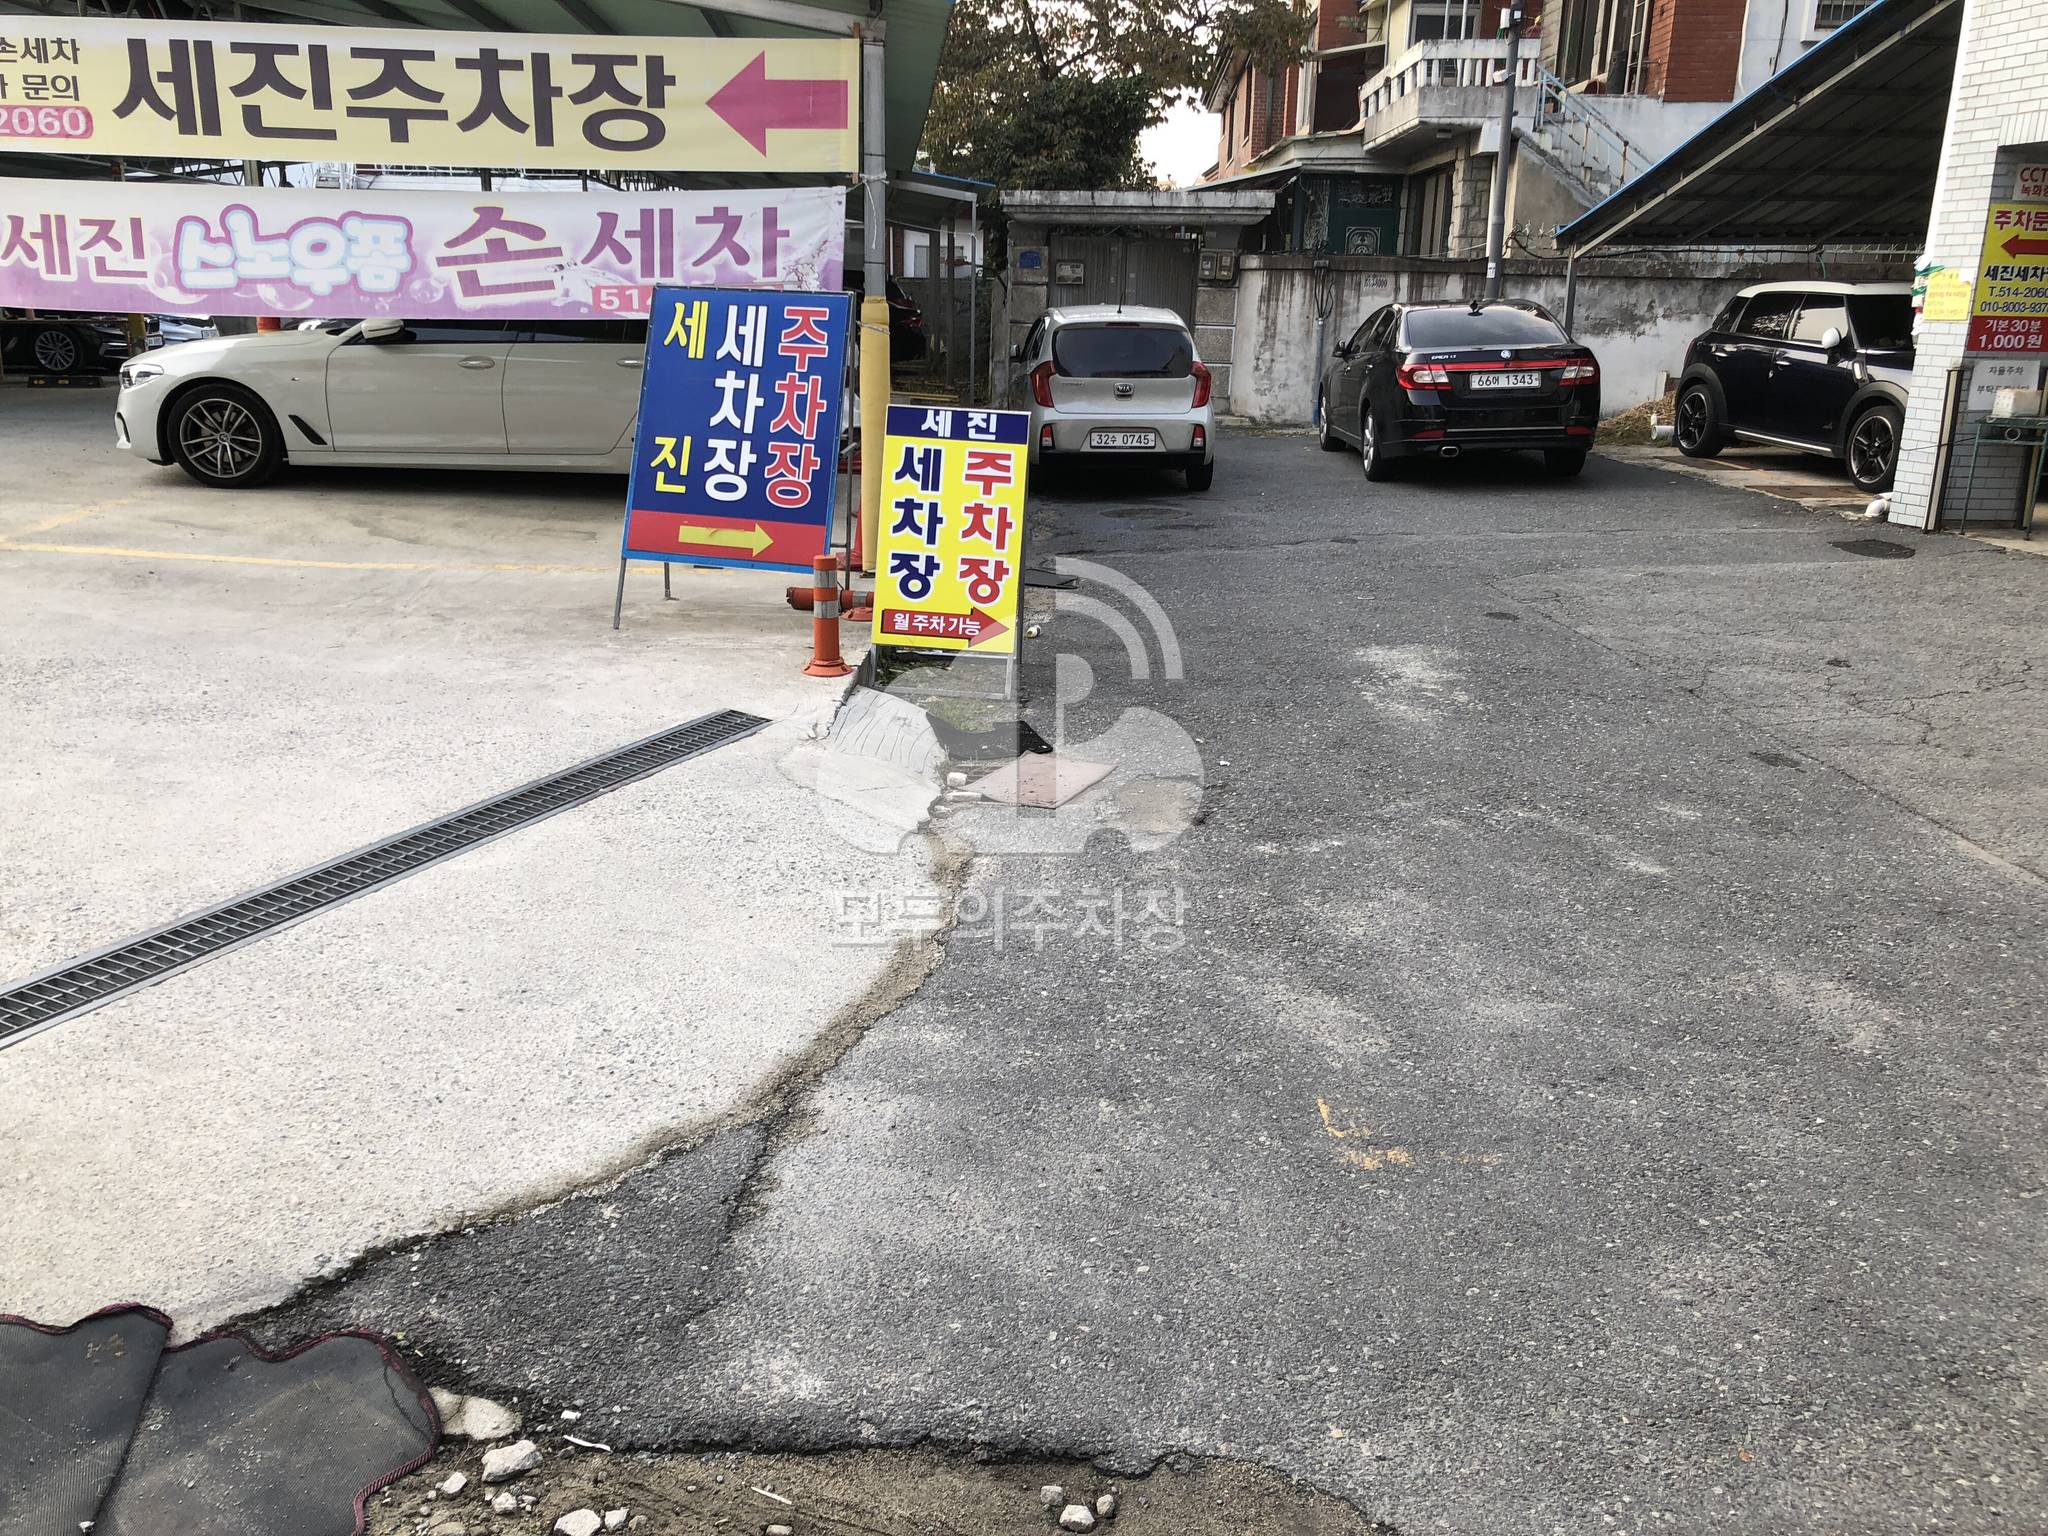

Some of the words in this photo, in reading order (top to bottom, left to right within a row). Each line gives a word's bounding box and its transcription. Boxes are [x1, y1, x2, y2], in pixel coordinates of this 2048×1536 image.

[22, 74, 79, 101] 문의
[112, 38, 676, 152] 세진주차장
[1, 214, 148, 278] 세진
[600, 287, 652, 310] 51
[703, 304, 769, 502] 세차장
[765, 306, 829, 508] 주차장
[1506, 374, 1533, 385] 1343
[1122, 434, 1149, 445] 0745
[889, 446, 944, 600] 세차장
[959, 450, 1013, 605] 주차장
